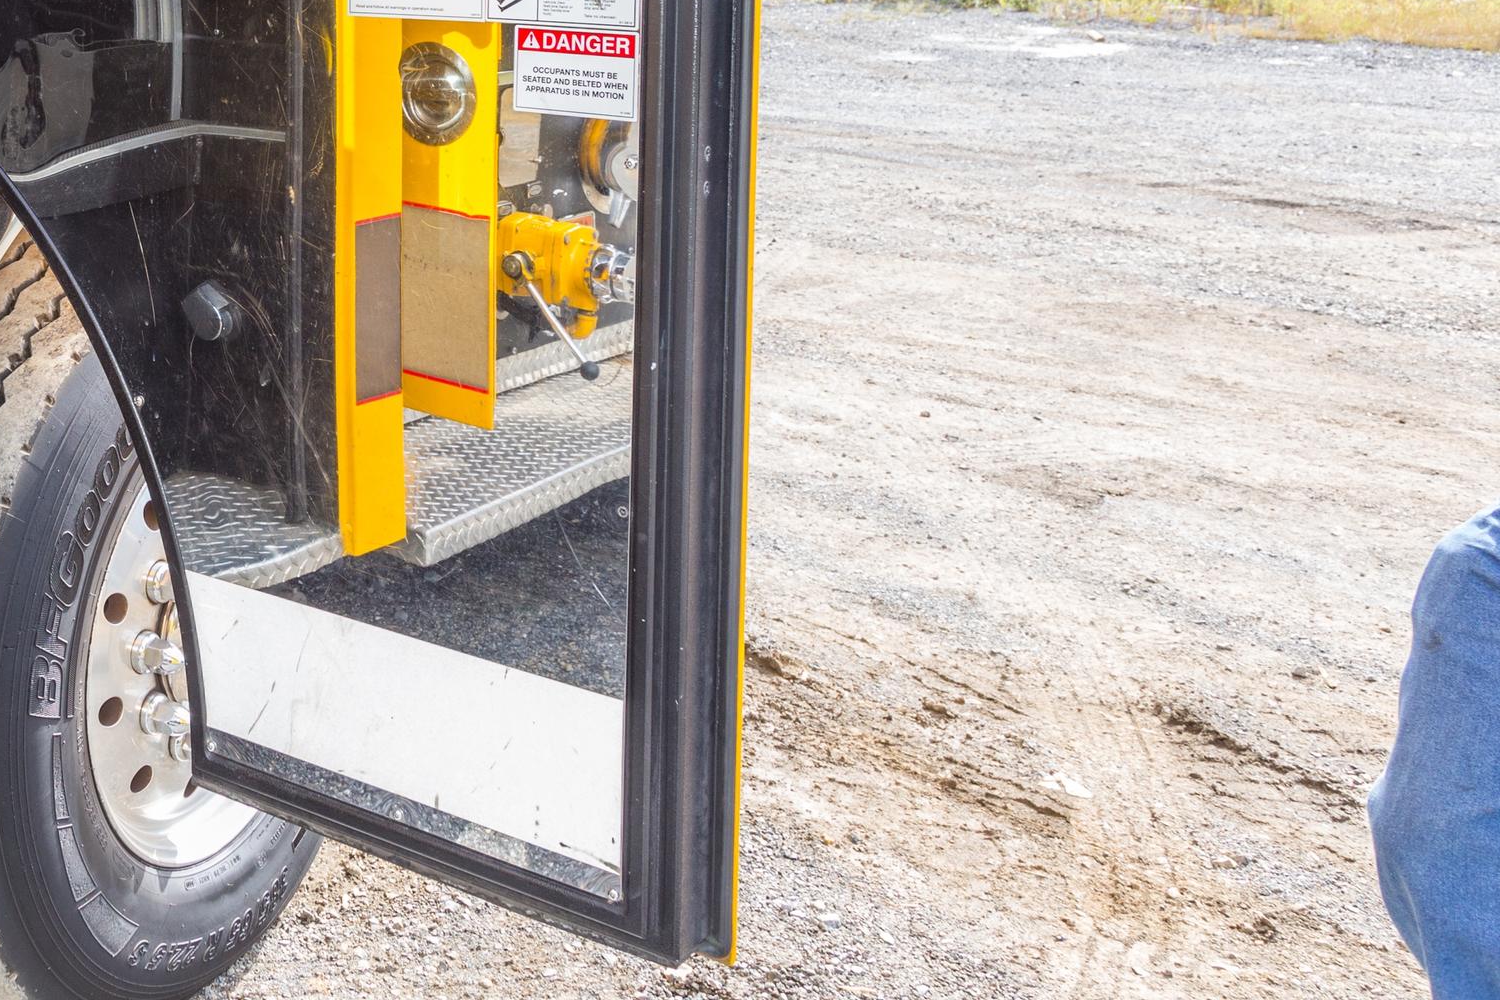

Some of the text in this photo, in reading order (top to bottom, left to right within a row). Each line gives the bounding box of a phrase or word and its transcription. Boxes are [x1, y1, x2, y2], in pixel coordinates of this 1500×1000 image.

[542, 32, 630, 55] DANGER
[532, 66, 618, 80] OCCUPANTS MUST BE
[522, 75, 628, 91] SEATED AND BELTED WHEN
[525, 85, 571, 96] APPARATUS
[591, 91, 625, 100] MOTION
